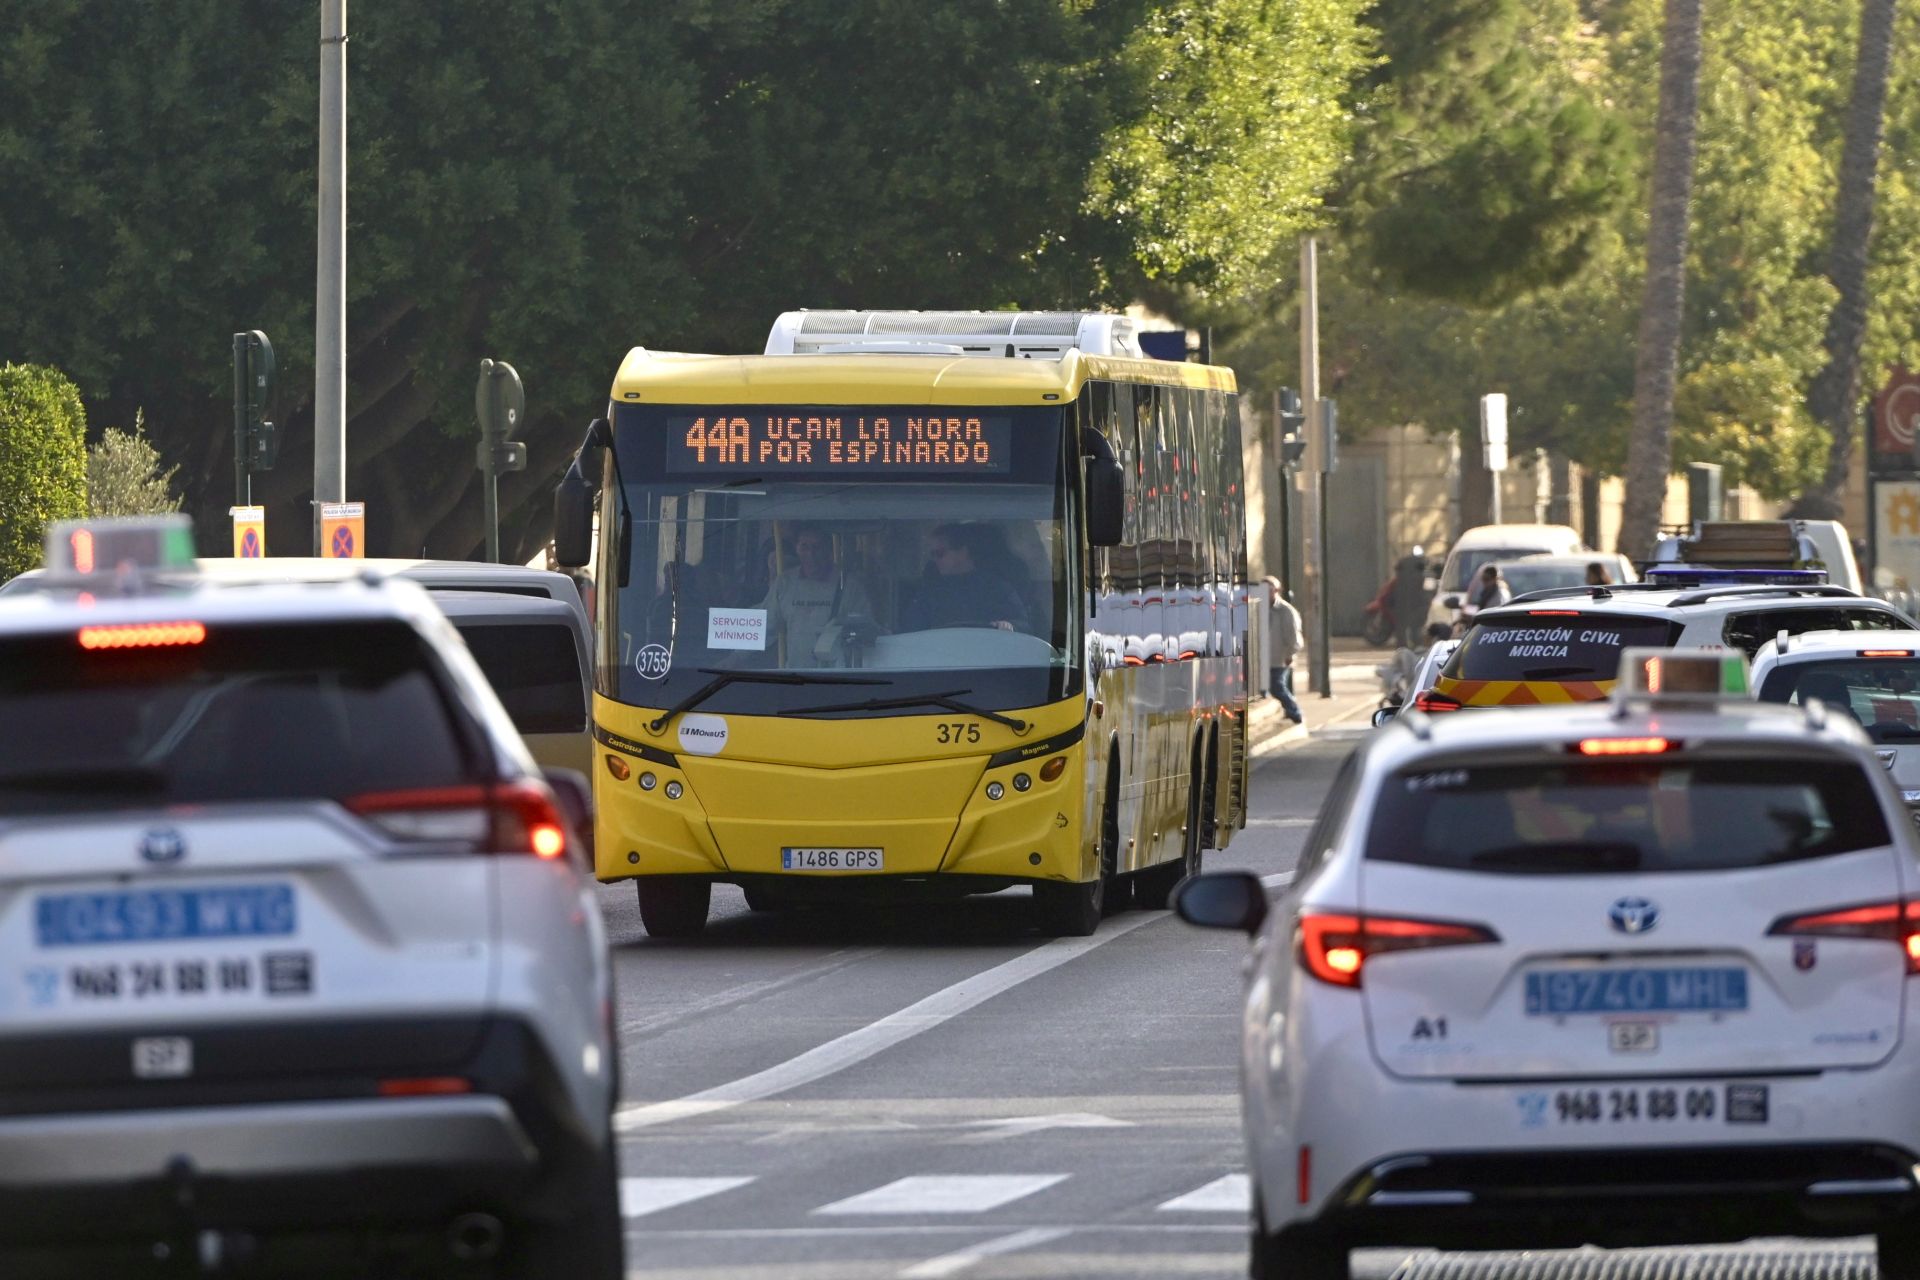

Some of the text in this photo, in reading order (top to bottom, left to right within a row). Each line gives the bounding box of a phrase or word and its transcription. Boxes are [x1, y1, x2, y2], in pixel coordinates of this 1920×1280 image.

[767, 418, 981, 439] UCAM LA NORA
[686, 418, 750, 463] 44A
[760, 441, 989, 463] POR ESPINARDO
[712, 617, 762, 627] SERVICIOS
[714, 630, 759, 641] MÍNIMOS
[1478, 627, 1621, 645] PROTECCIÓN CIVIL
[639, 651, 668, 673] 3755
[1508, 645, 1569, 658] MURCIA
[936, 723, 981, 744] 375
[797, 850, 839, 867] 1486
[845, 850, 878, 867] GPS
[1412, 1017, 1448, 1039] A1
[1555, 1091, 1600, 1124] 968
[1608, 1089, 1639, 1121] 24
[1647, 1088, 1678, 1119] 88
[1685, 1087, 1716, 1119] 00
